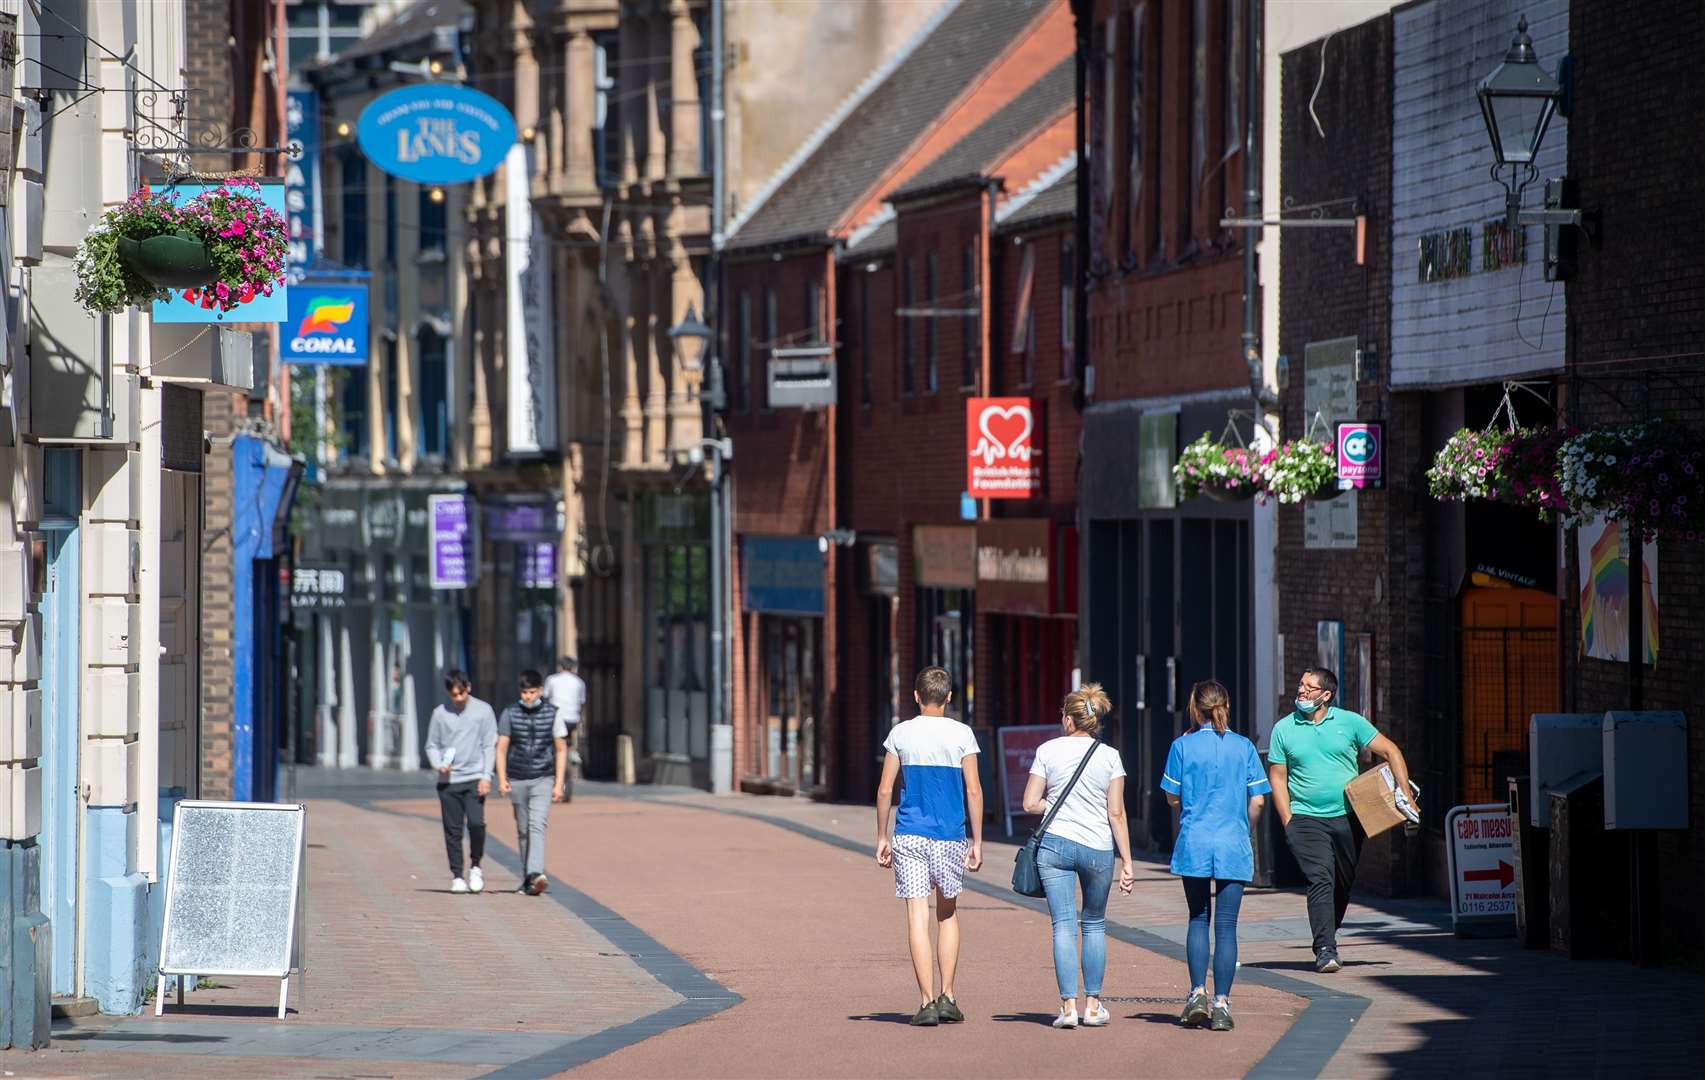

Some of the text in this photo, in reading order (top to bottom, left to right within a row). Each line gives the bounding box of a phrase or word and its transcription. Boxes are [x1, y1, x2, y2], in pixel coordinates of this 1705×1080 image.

[417, 117, 457, 138] THE
[397, 128, 481, 165] LANES
[290, 337, 356, 353] CORAL
[1341, 466, 1378, 477] payzone
[972, 478, 1040, 490] Foundation
[1457, 818, 1511, 840] tape measu
[1462, 900, 1515, 913] 0116 25371
